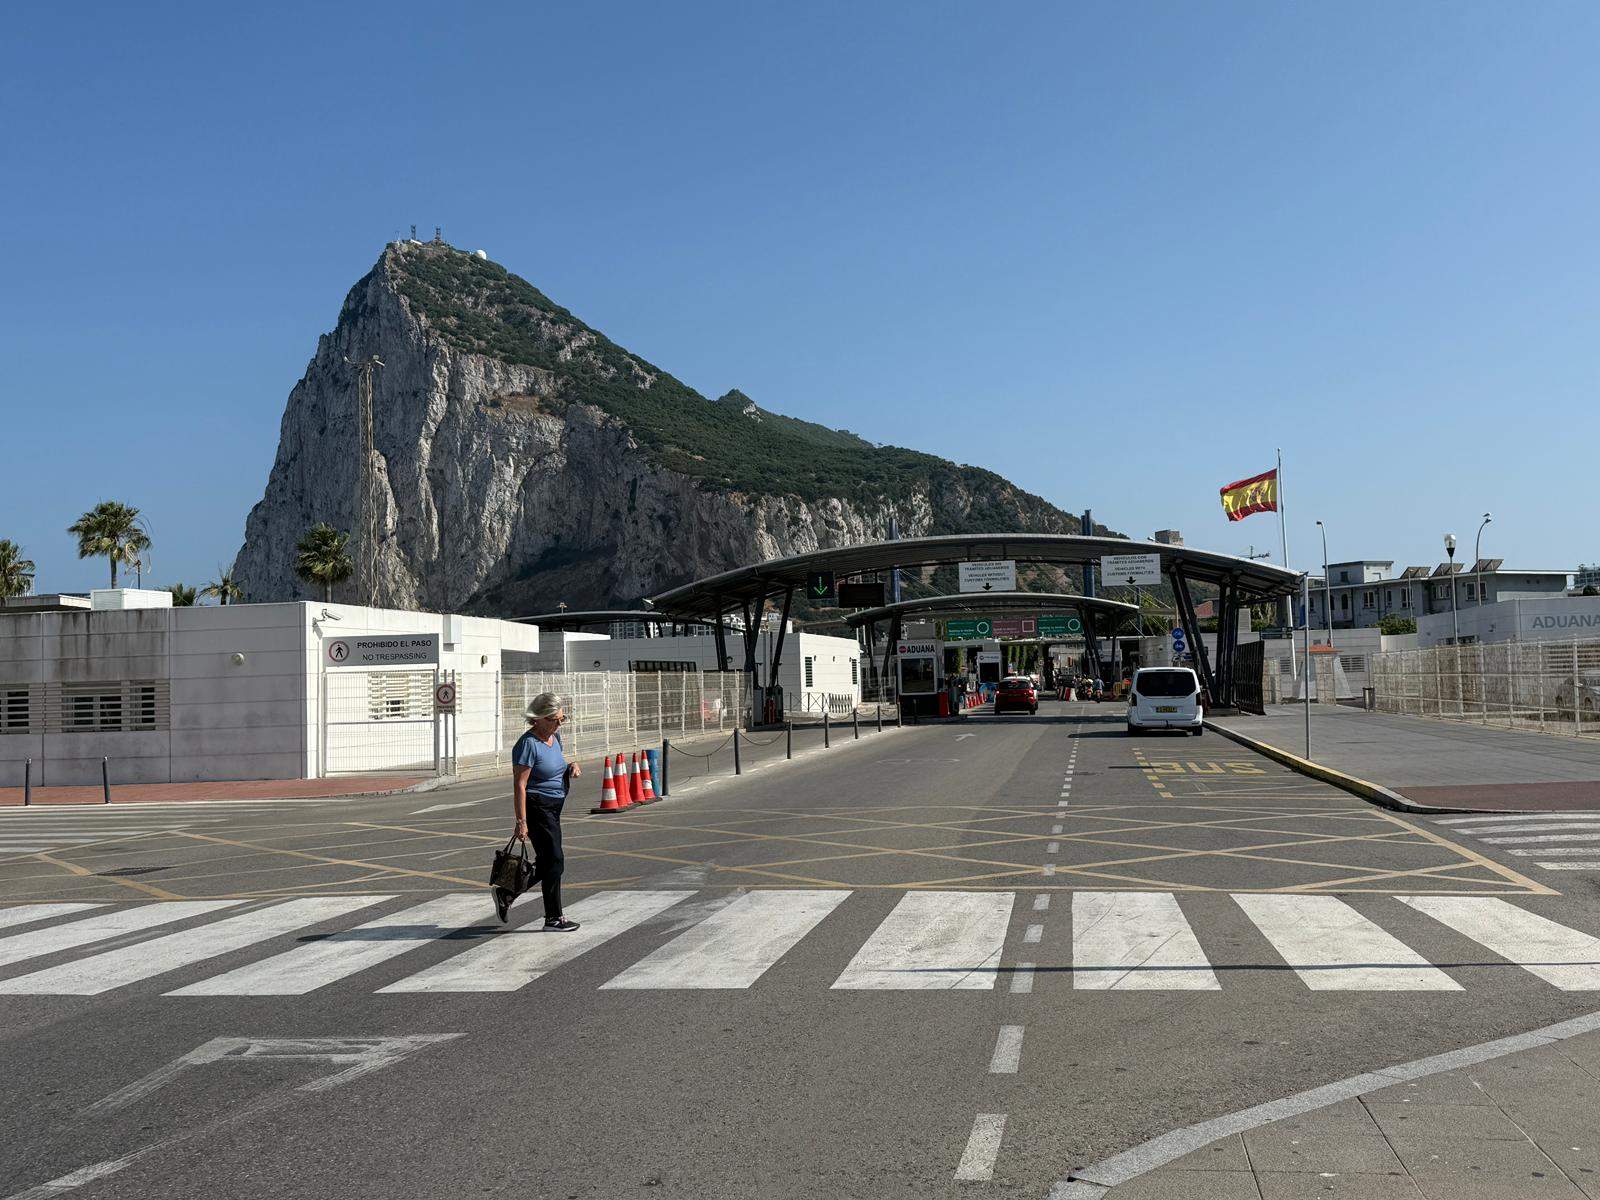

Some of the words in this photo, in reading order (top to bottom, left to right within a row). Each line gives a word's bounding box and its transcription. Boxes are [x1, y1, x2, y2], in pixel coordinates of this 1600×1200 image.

[1532, 614, 1600, 629] ADUANA
[907, 644, 935, 653] ADUANA
[376, 652, 427, 660] TRESPASSING
